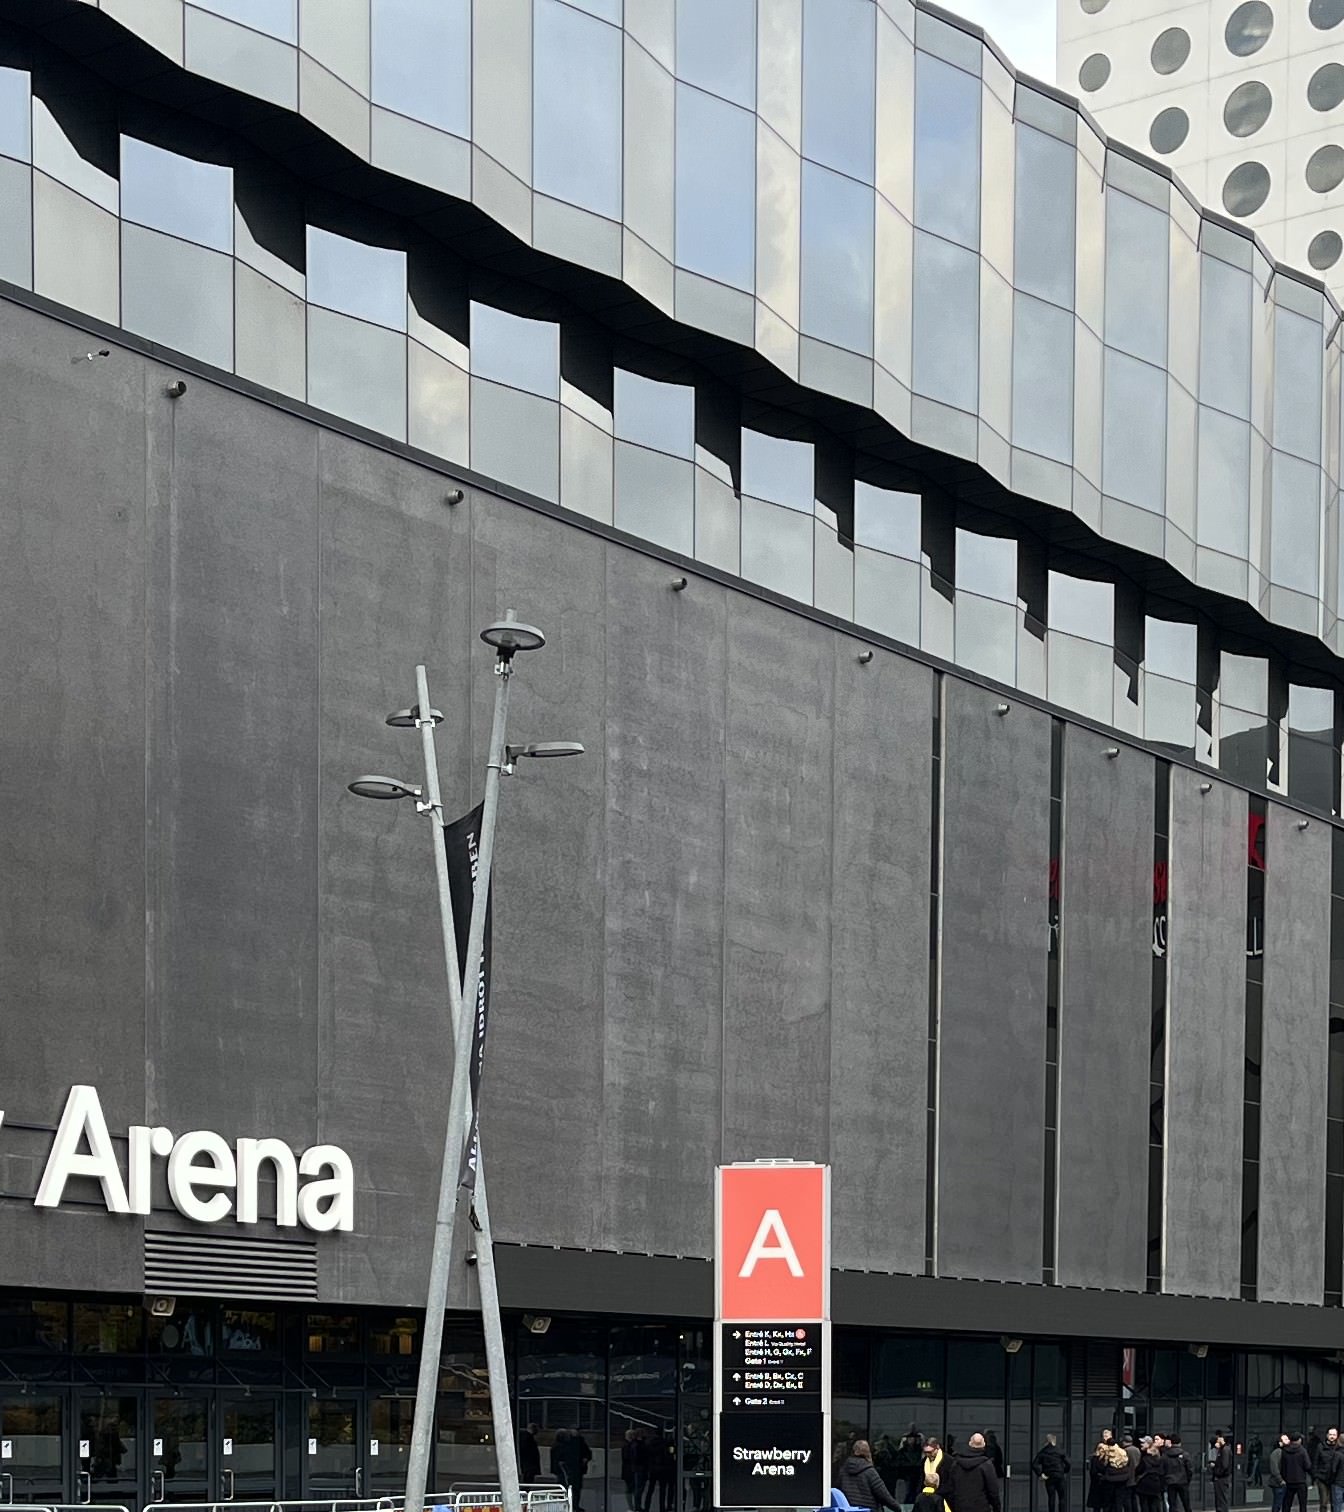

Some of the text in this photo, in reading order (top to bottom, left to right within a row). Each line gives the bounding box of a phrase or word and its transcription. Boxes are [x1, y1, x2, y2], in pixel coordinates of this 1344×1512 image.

[34, 1085, 354, 1232] Arena
[738, 1209, 804, 1278] A
[733, 1446, 811, 1463] Strawberry
[751, 1462, 795, 1475] Arena
